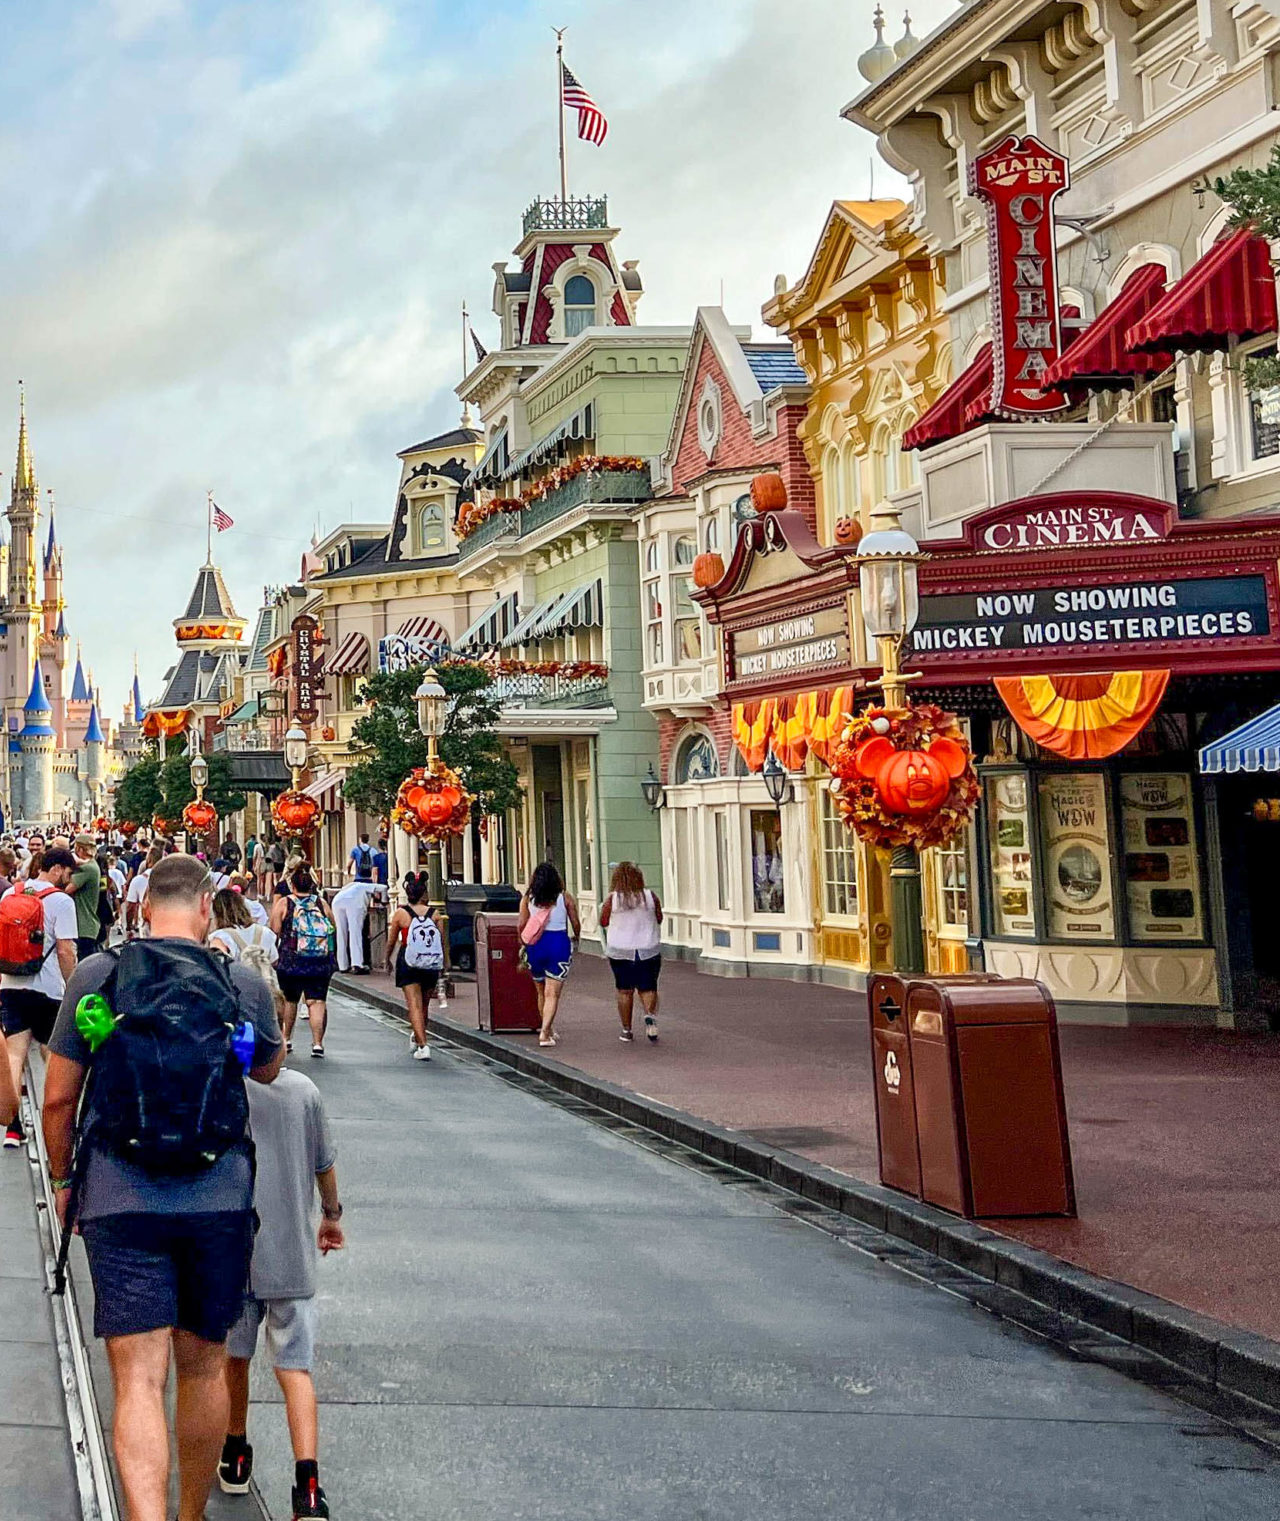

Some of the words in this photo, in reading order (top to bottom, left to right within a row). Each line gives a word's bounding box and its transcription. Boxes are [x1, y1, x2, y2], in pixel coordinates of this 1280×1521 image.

[985, 157, 1054, 181] MAIN
[1028, 169, 1063, 184] ST.
[1009, 193, 1055, 380] CINEMA
[983, 513, 1159, 549] CINEMA
[1026, 508, 1082, 526] MAIN
[976, 594, 1035, 617] NOW
[1054, 585, 1177, 613] SHOWING
[757, 627, 775, 646] NOW
[778, 617, 815, 641] SHOWING
[913, 625, 1005, 650] MICKEY
[1022, 612, 1253, 644] MOUSETERPIECES
[299, 630, 310, 676] CRYSTAL
[741, 654, 767, 675] MICKEY
[770, 639, 838, 670] MOUSETERPIECES
[300, 682, 310, 710] ARTS
[1050, 792, 1085, 809] MAGIC
